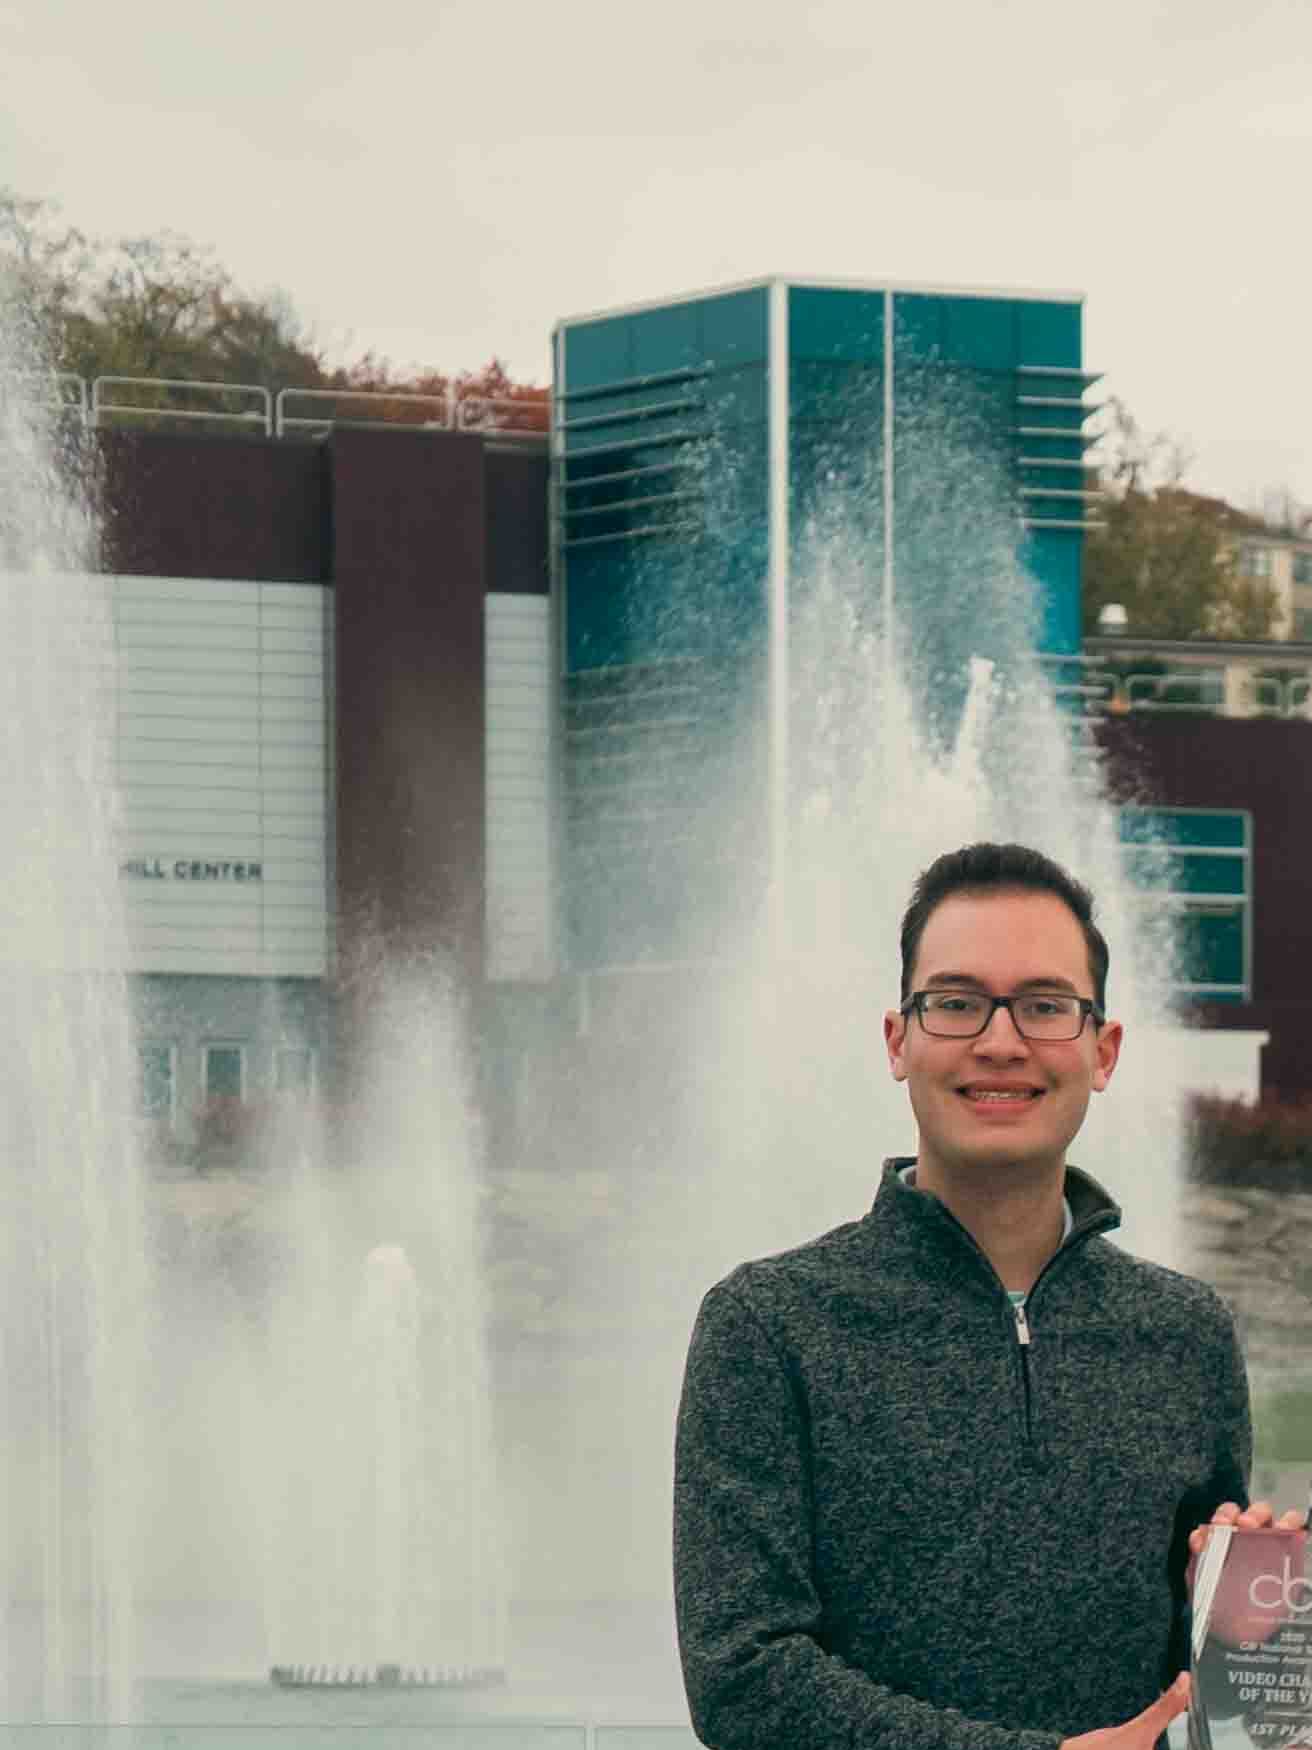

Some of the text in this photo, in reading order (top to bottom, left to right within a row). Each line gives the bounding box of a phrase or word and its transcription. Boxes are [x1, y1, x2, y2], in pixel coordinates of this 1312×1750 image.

[174, 861, 263, 882] CENTER
[1228, 1671, 1277, 1687] VIDEO
[1239, 1687, 1261, 1702] OF
[1263, 1688, 1297, 1704] THE
[1250, 1722, 1275, 1737] 1ST
